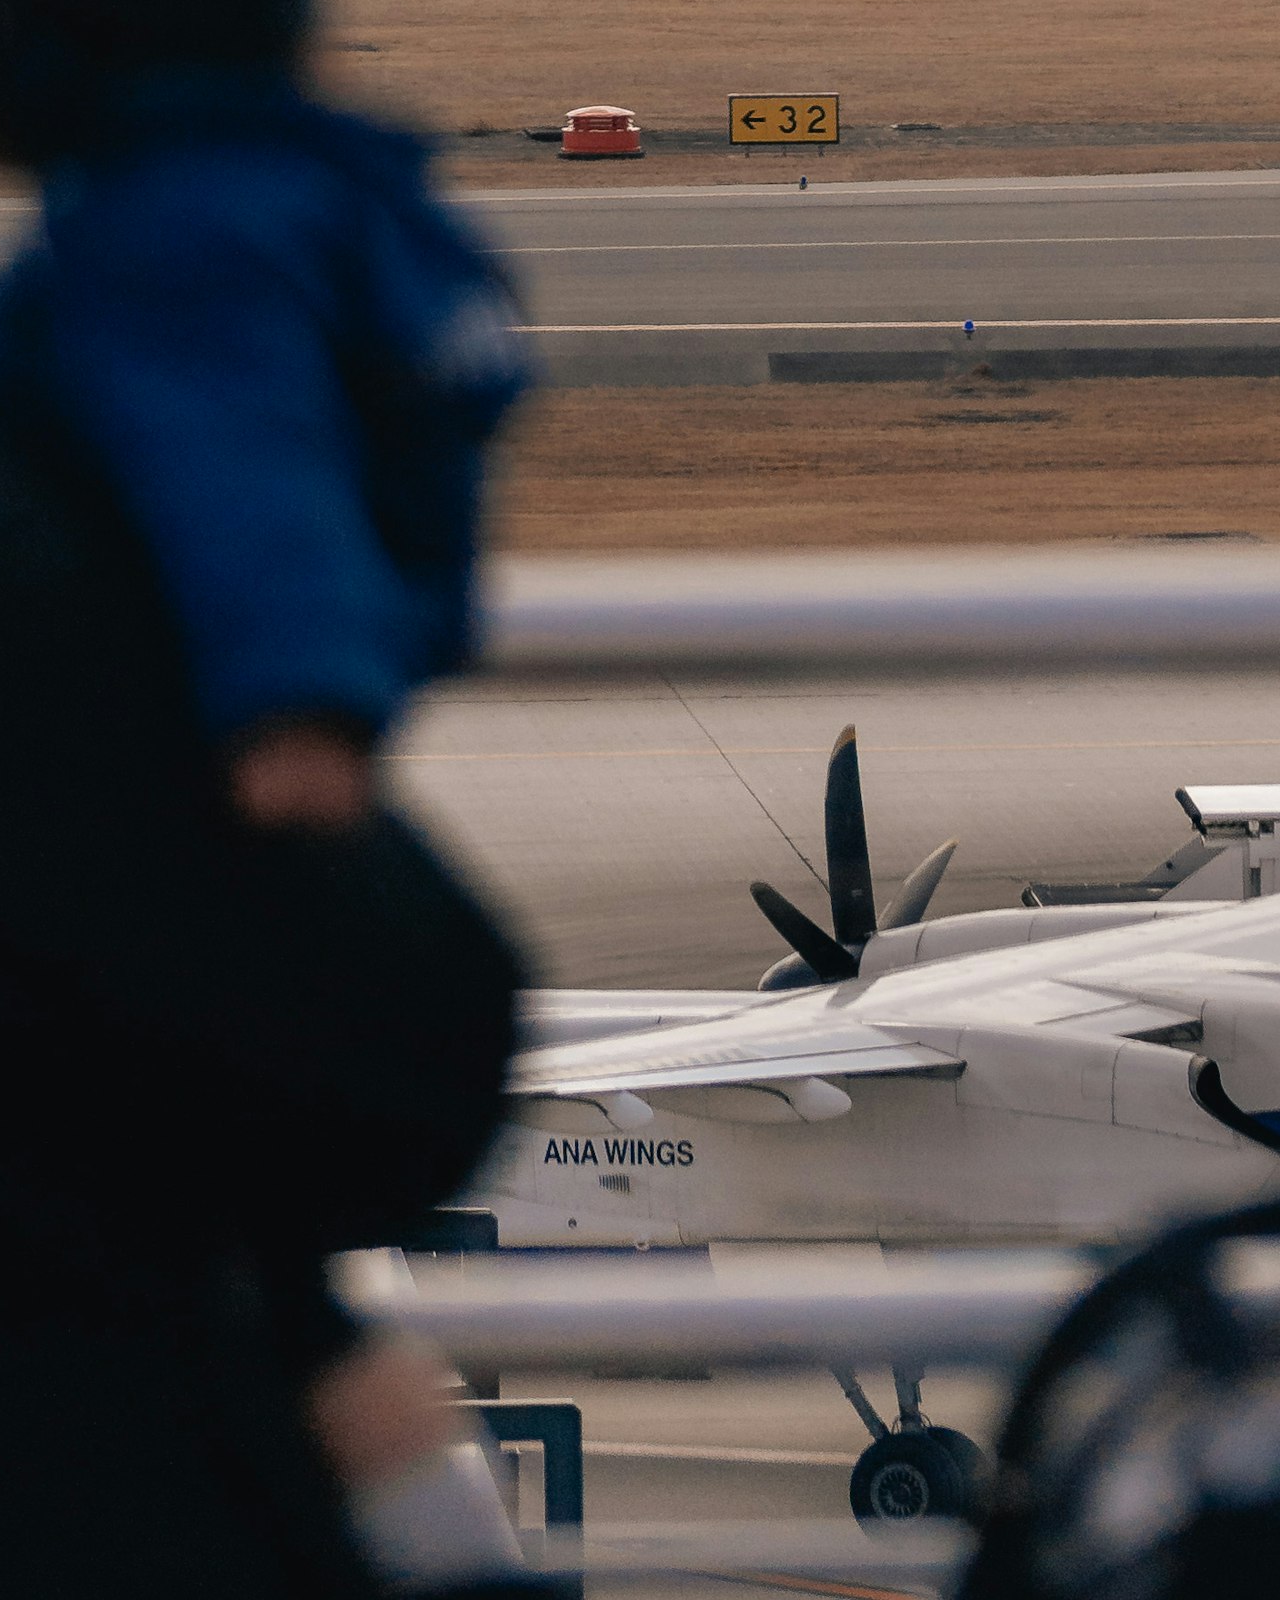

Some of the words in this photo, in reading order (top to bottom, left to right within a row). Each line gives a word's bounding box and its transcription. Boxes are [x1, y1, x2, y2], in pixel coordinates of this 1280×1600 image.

[778, 105, 827, 134] 32
[544, 1138, 599, 1165] ANA
[603, 1138, 695, 1167] WINGS
